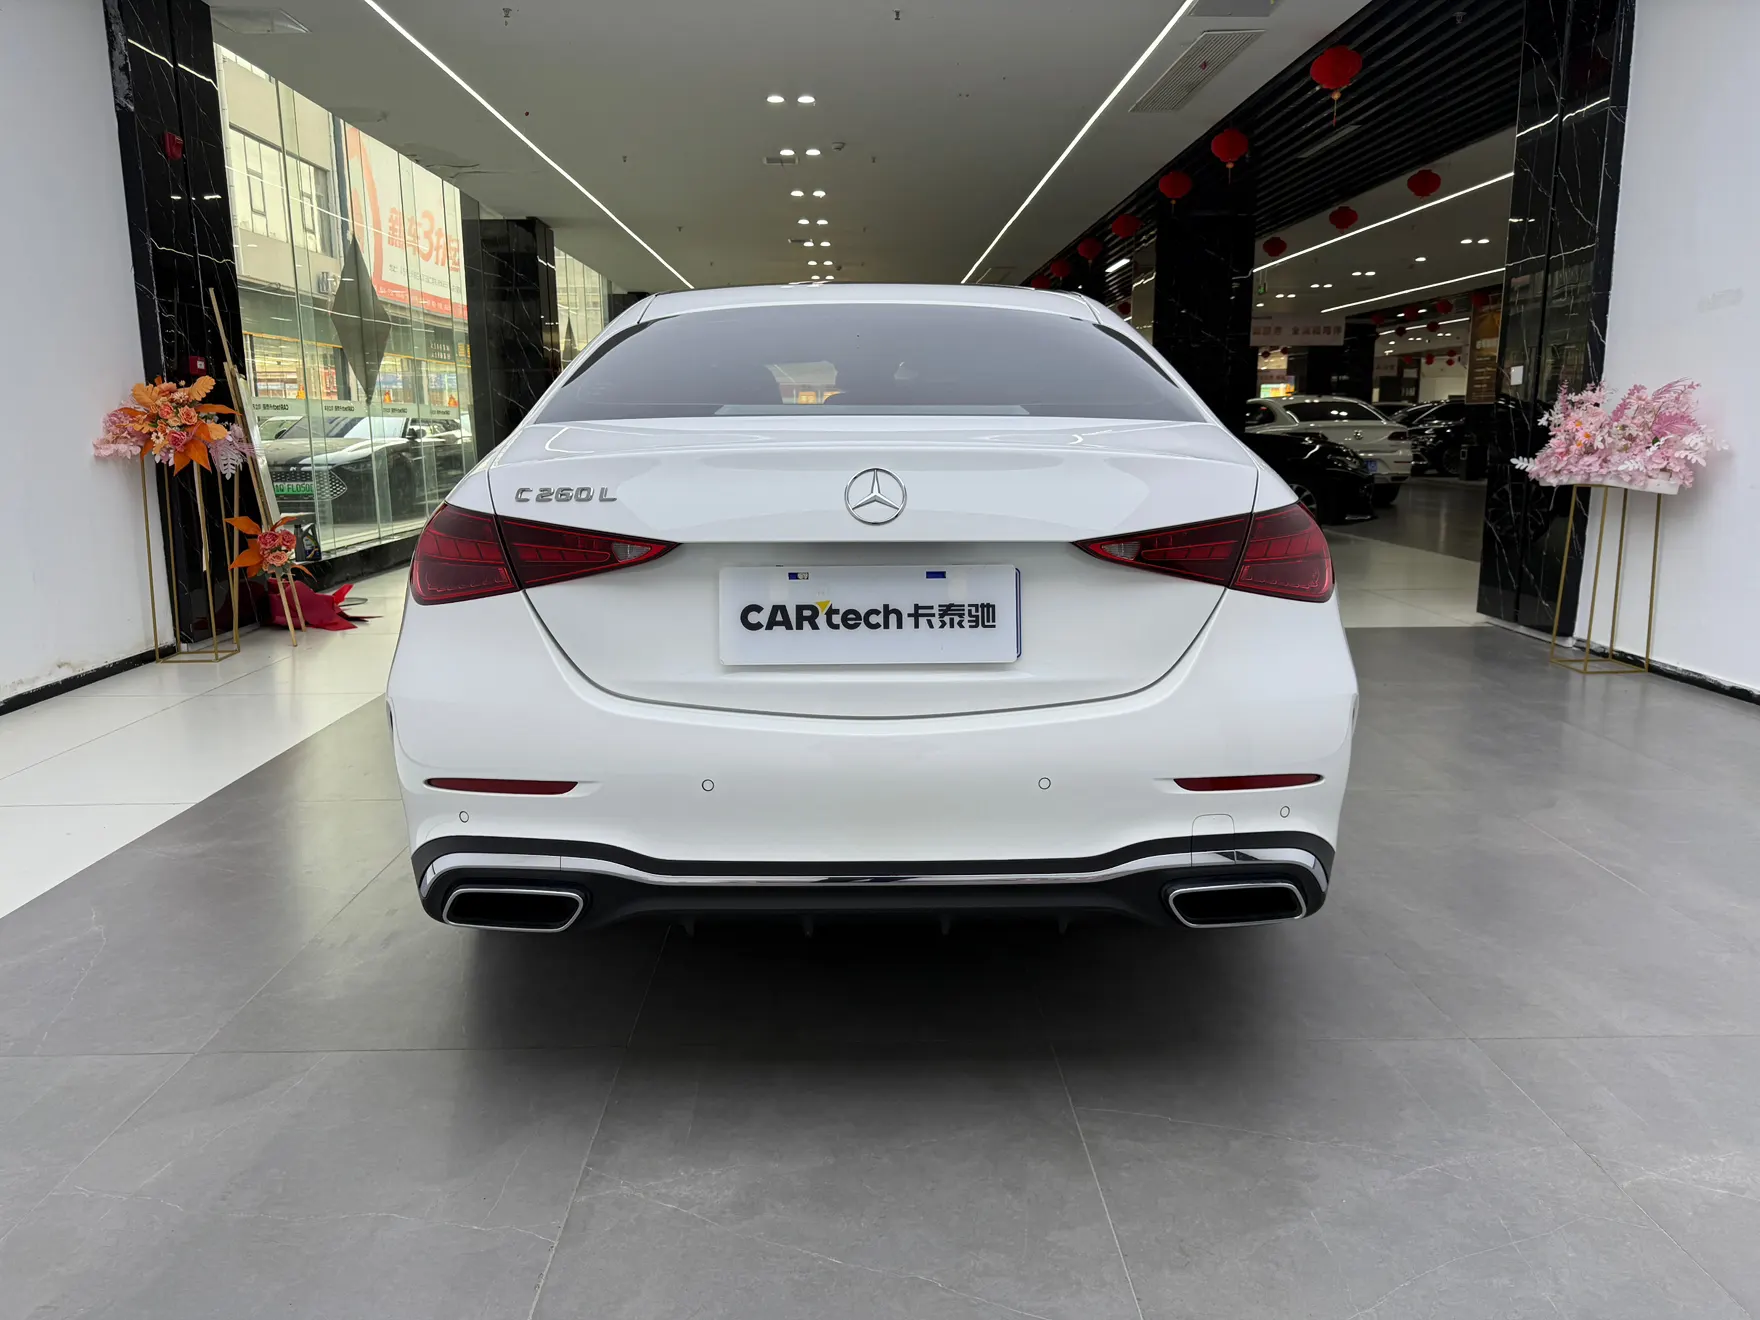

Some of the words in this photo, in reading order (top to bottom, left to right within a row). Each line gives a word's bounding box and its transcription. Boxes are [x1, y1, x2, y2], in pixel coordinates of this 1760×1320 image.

[515, 487, 533, 503] C
[535, 486, 595, 503] 260
[598, 486, 618, 502] L
